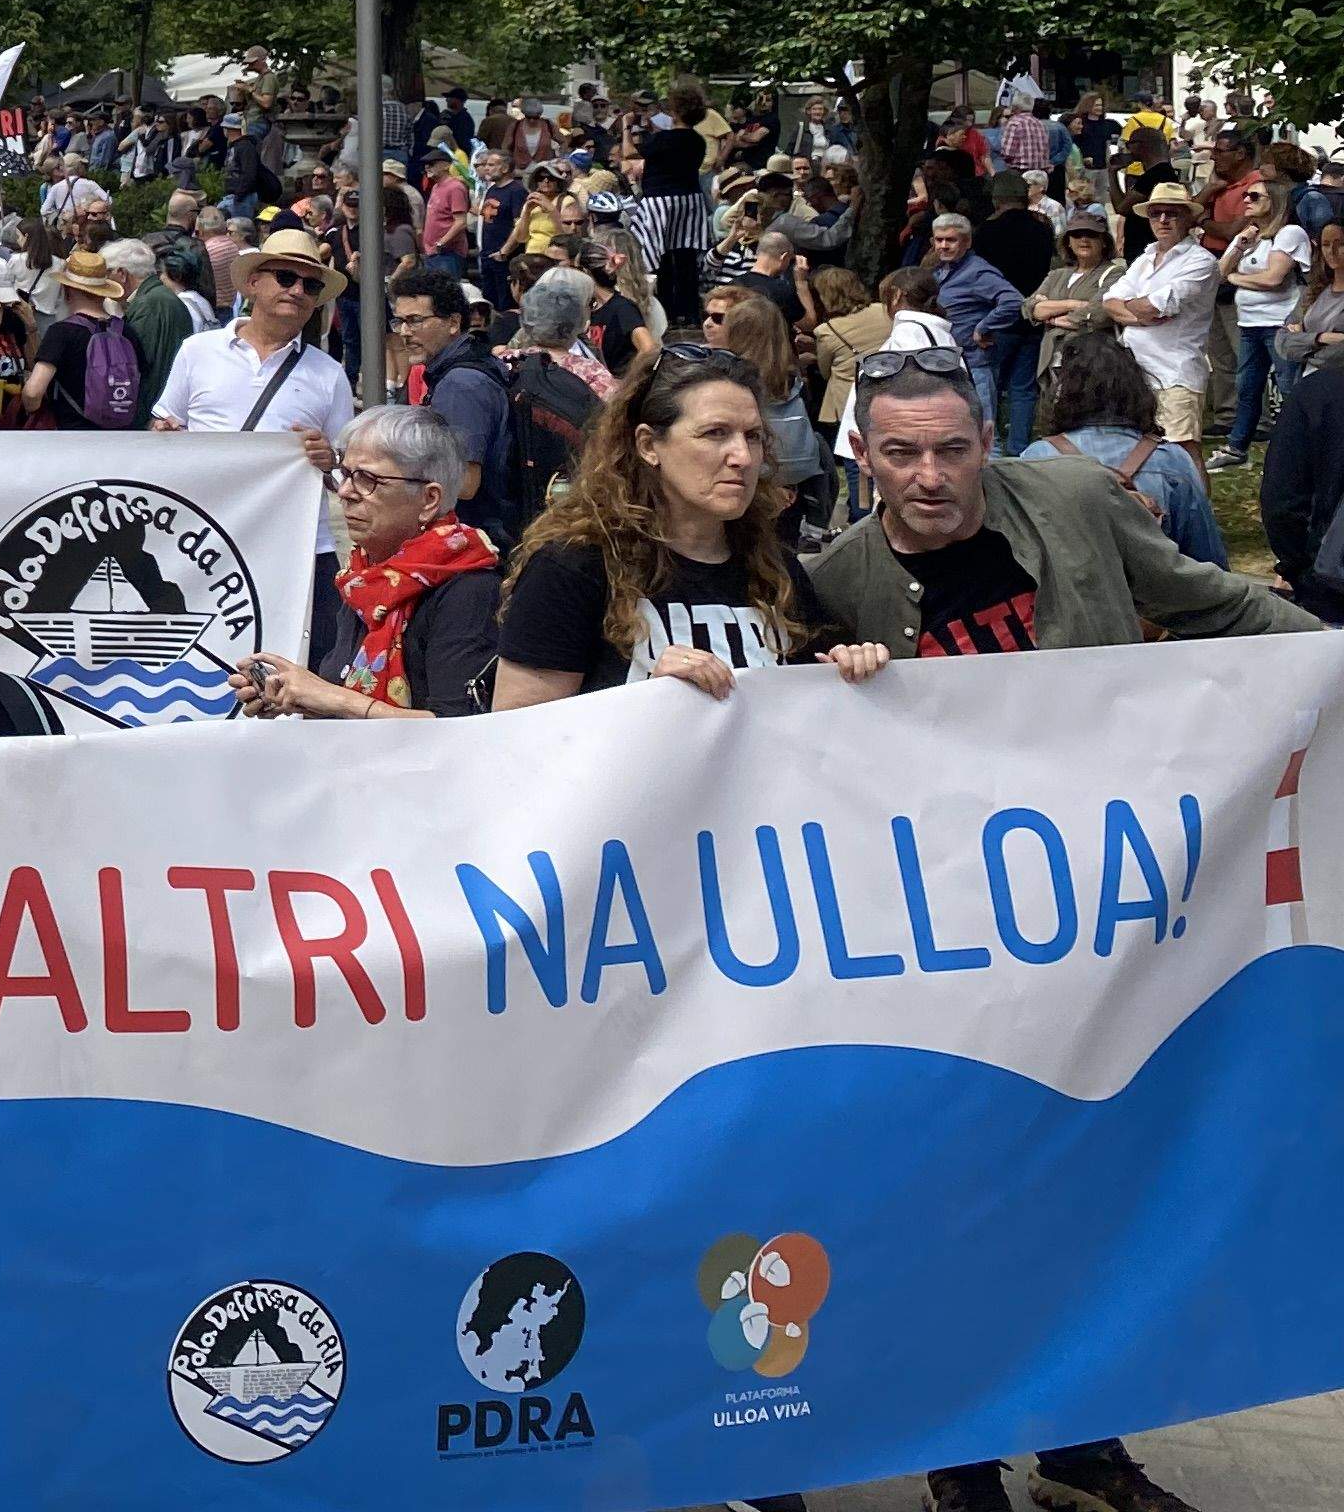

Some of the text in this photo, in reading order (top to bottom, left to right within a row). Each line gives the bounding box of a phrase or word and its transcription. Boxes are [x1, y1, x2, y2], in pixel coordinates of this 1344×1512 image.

[25, 492, 179, 554] Defensa
[177, 526, 222, 576] da
[208, 571, 255, 641] RIA
[625, 598, 788, 685] ALTR
[455, 838, 668, 1015] NA
[696, 794, 1202, 988] ULLOA!
[204, 1288, 300, 1331] Defensa
[298, 1307, 325, 1338] da
[316, 1334, 343, 1378] RIA
[437, 1392, 595, 1451] PDRA
[713, 1400, 811, 1428] ULLOA VIVA
[725, 1385, 800, 1404] PLATAFORMA
